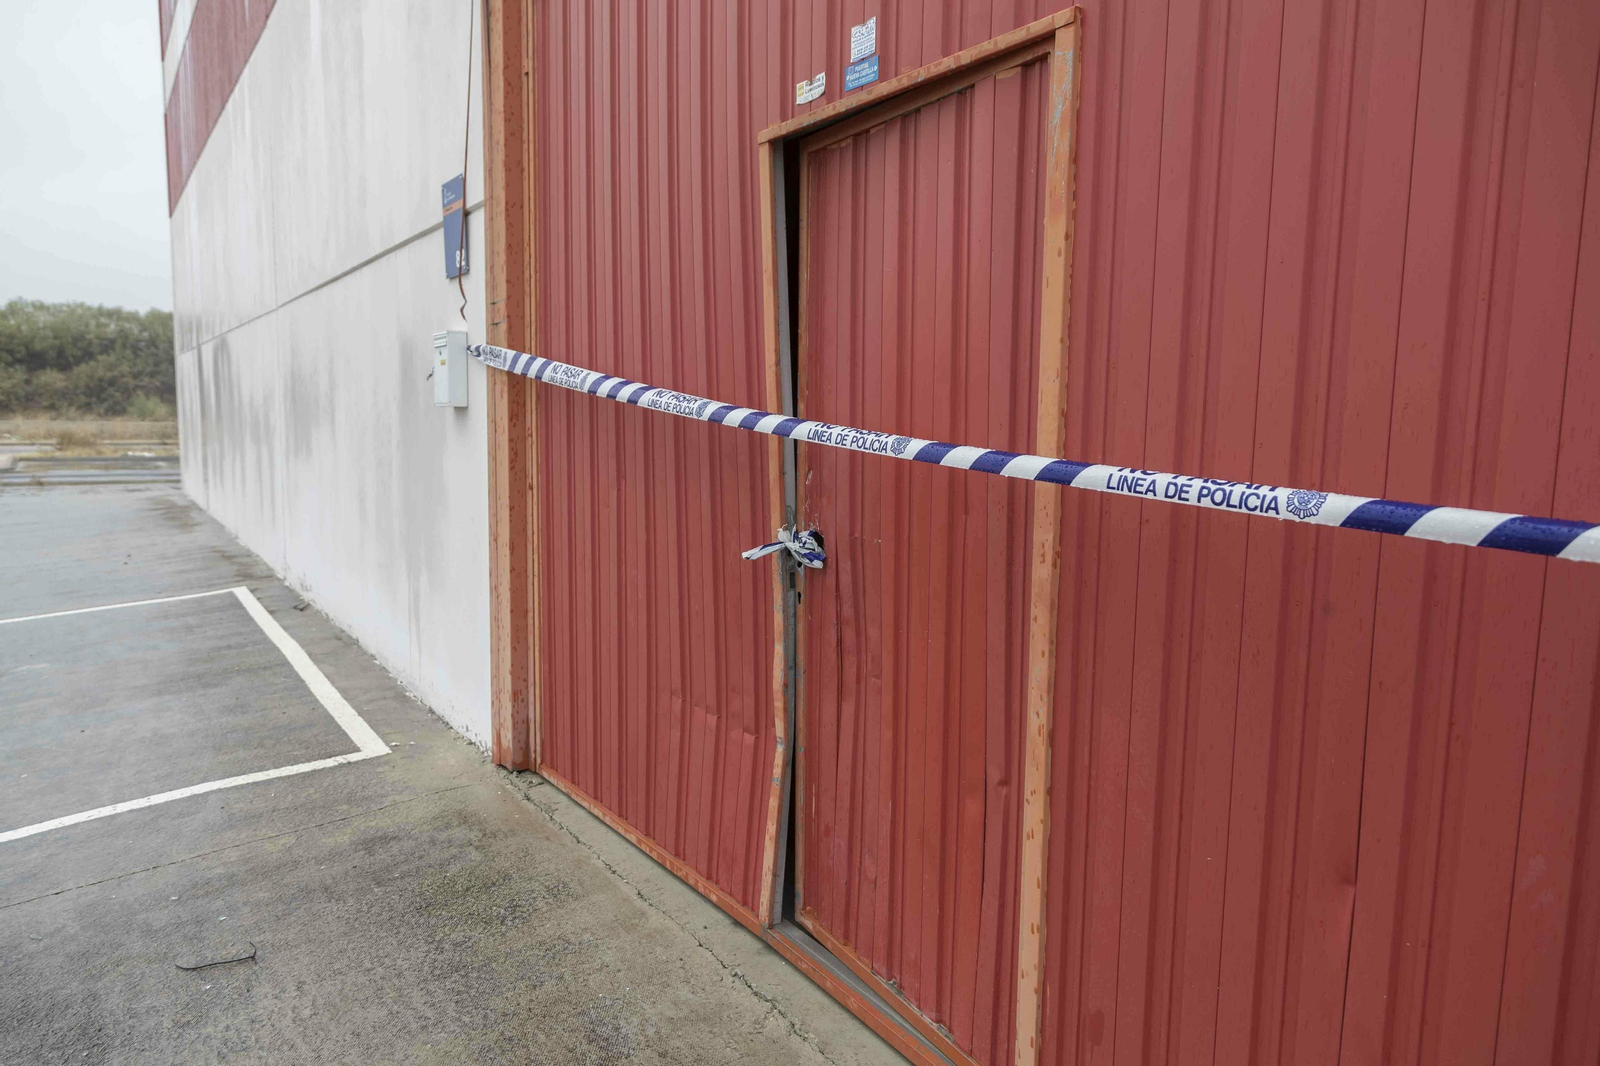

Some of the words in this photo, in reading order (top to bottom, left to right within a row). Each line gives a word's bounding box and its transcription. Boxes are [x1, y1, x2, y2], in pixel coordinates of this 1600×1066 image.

[550, 363, 562, 375] NO
[561, 366, 584, 380] PASAR
[548, 374, 559, 384] LINEA
[564, 379, 579, 389] POLICIA
[647, 398, 663, 410] LINEA
[664, 401, 672, 411] DE
[672, 403, 694, 417] POLICIA
[807, 428, 832, 444] LINEA
[834, 433, 849, 447] DE
[850, 435, 889, 454] POLICIA
[1106, 473, 1157, 497] LINEA
[1164, 481, 1190, 501] DE
[1197, 485, 1280, 515] POLICIA
